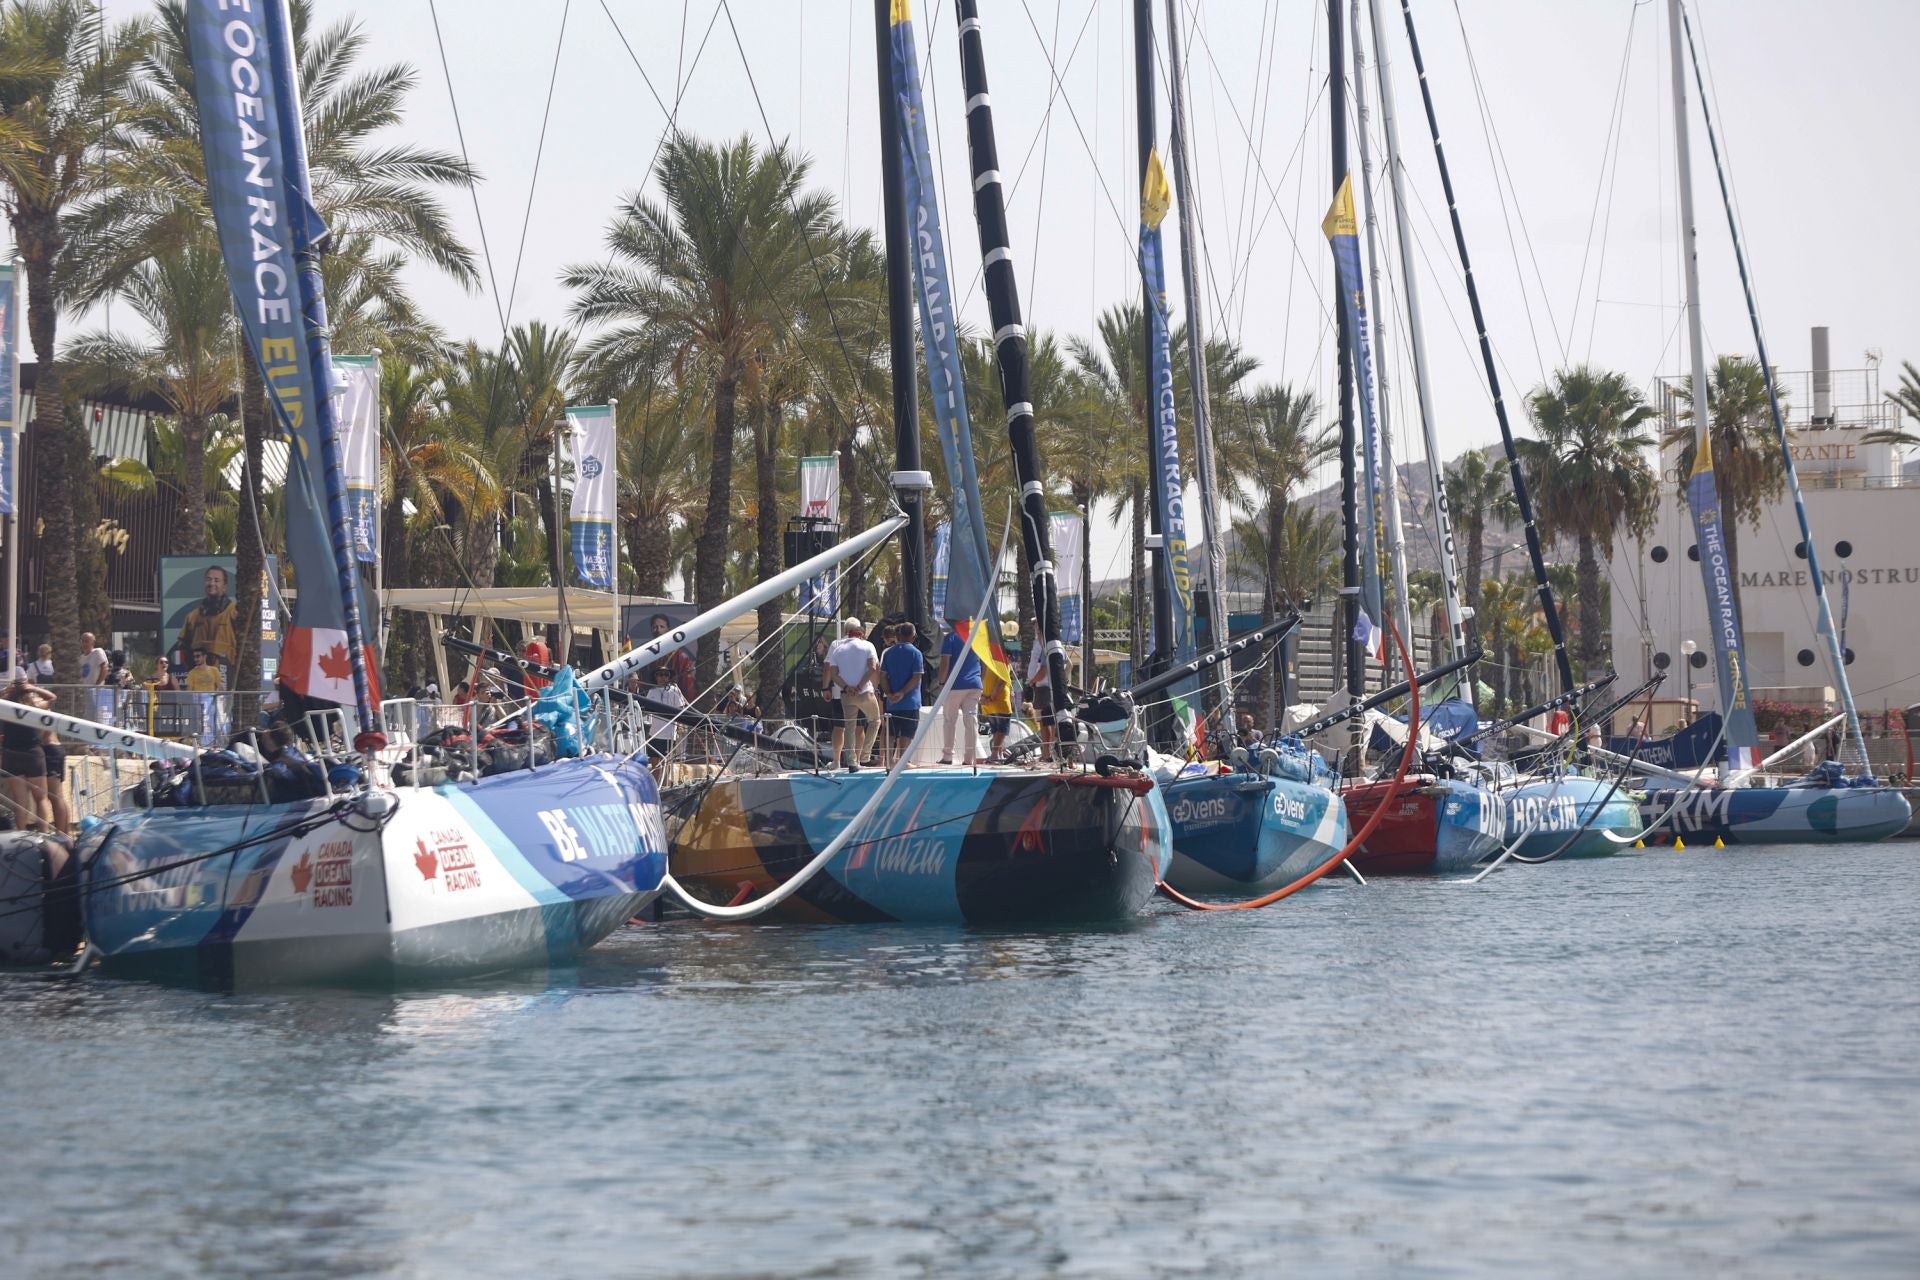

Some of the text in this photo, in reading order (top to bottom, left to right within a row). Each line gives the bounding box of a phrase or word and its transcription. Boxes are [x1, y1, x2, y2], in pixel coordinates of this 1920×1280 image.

[223, 20, 273, 187] OCEAN
[247, 195, 292, 324] RACE
[1164, 463, 1185, 533] RACE
[1704, 523, 1721, 554] THE
[1711, 554, 1729, 607] OCEAN
[1741, 571, 1807, 588] MARE
[1719, 607, 1737, 648] RACE
[1187, 632, 1264, 671] VOLVO
[1543, 683, 1597, 710] VOLVO
[1727, 649, 1747, 710] EUROPE
[14, 707, 136, 748] VOLVO
[1299, 704, 1365, 737] VOLVO
[1512, 796, 1578, 833] HOLCIM
[319, 841, 352, 859] CANADA
[430, 829, 464, 845] CANADA
[537, 809, 588, 862] BE
[316, 863, 352, 884] OCEAN
[440, 849, 475, 869] OCEAN
[314, 888, 352, 908] RACING
[445, 870, 482, 892] RACING
